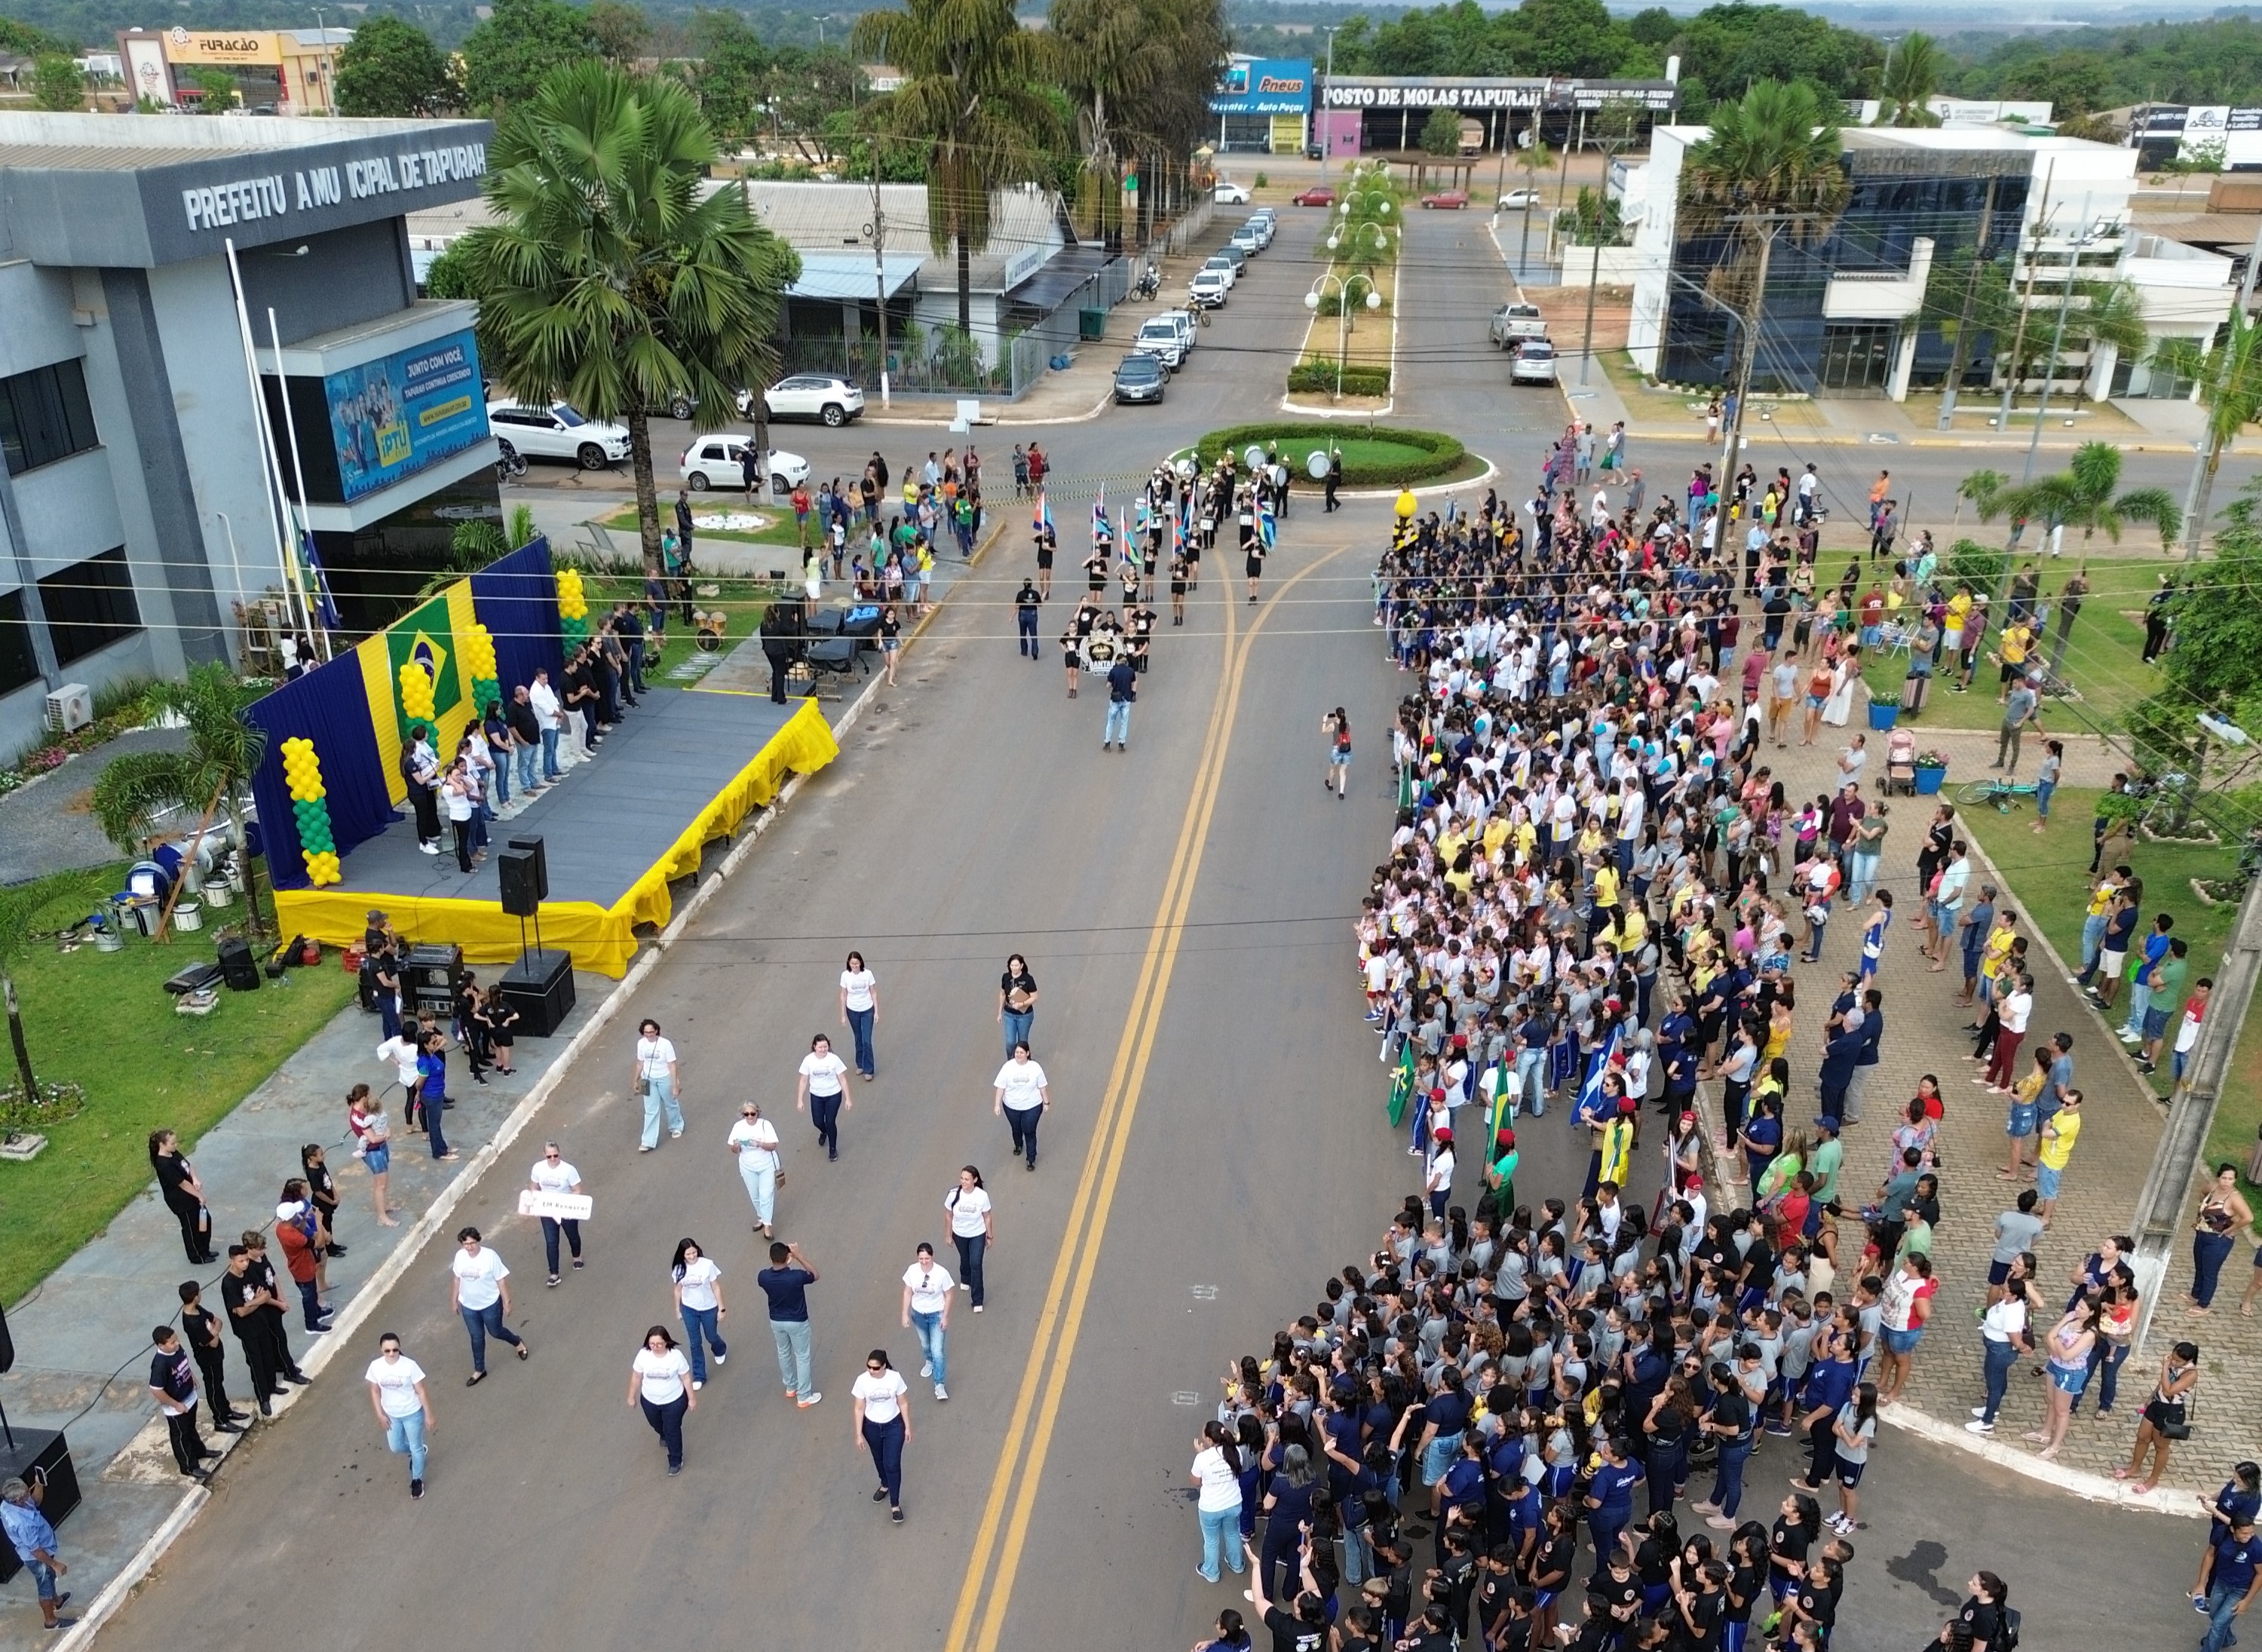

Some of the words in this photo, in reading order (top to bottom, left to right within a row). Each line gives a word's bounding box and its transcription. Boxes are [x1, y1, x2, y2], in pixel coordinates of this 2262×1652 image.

[1259, 76, 1303, 92] Pneus
[1323, 88, 1375, 106] POSTO
[1378, 88, 1400, 106] DE
[1402, 89, 1460, 106] MOLAS
[1256, 102, 1277, 112] Auto
[1278, 102, 1304, 113] Peças
[397, 154, 424, 189] DE
[420, 143, 487, 185] TAPURAH
[407, 360, 429, 378] JUNTO
[429, 354, 444, 369] COM
